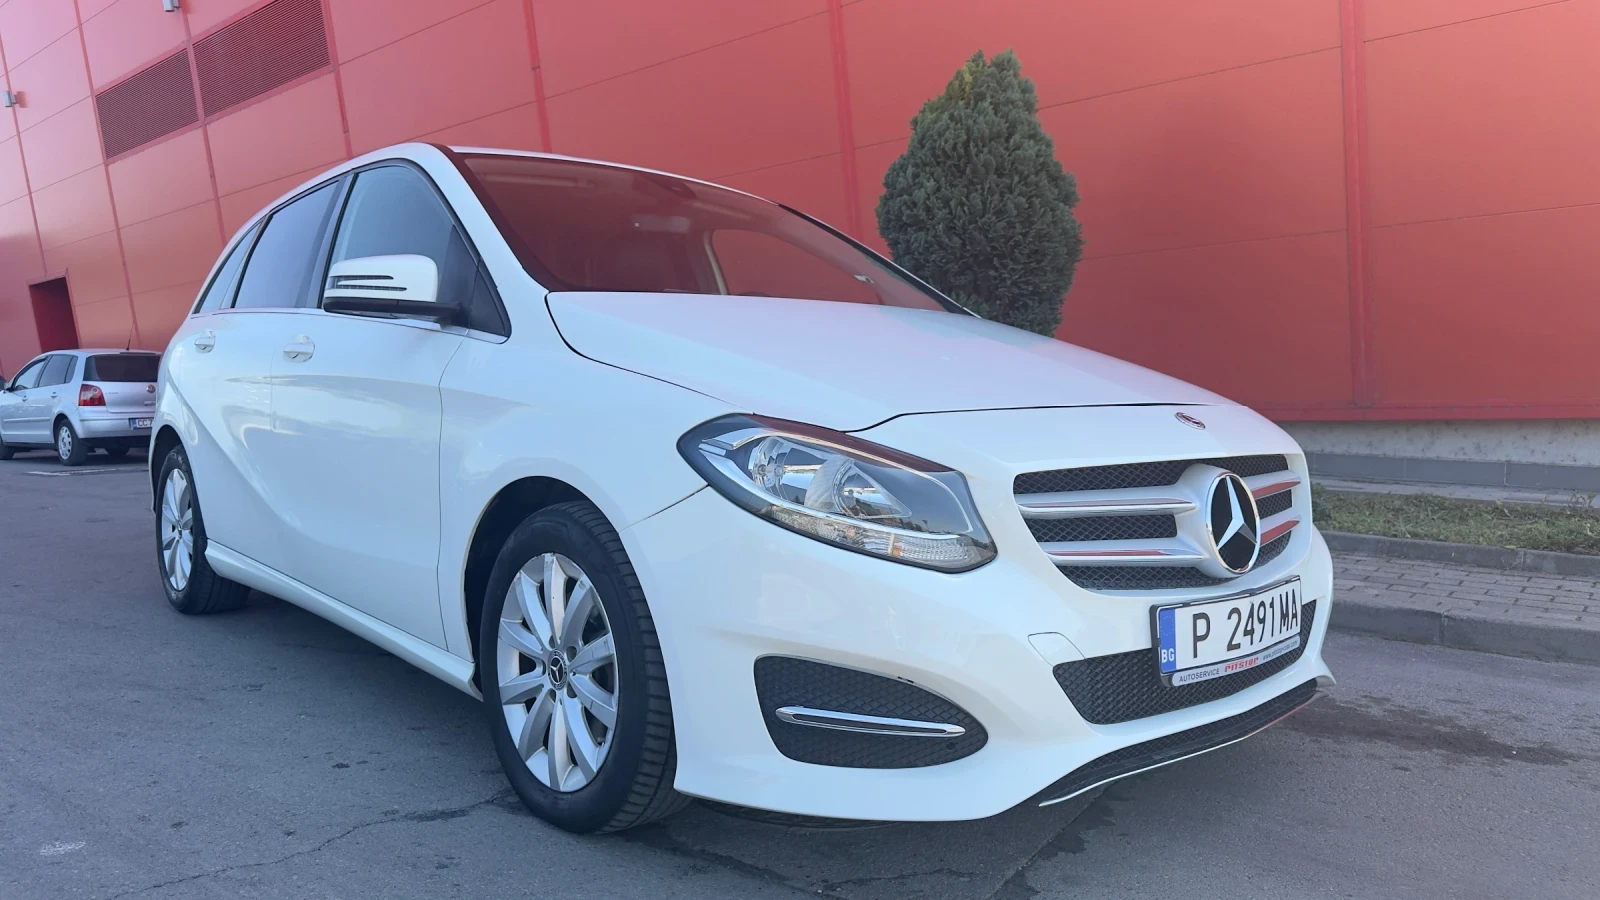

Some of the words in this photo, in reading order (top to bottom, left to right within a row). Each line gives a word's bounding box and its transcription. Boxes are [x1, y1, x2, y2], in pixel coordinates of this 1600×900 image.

[1192, 612, 1211, 659] P
[1161, 648, 1175, 663] BG
[1178, 667, 1220, 683] AUTOSERVICE
[1224, 657, 1259, 673] PITSTOP
